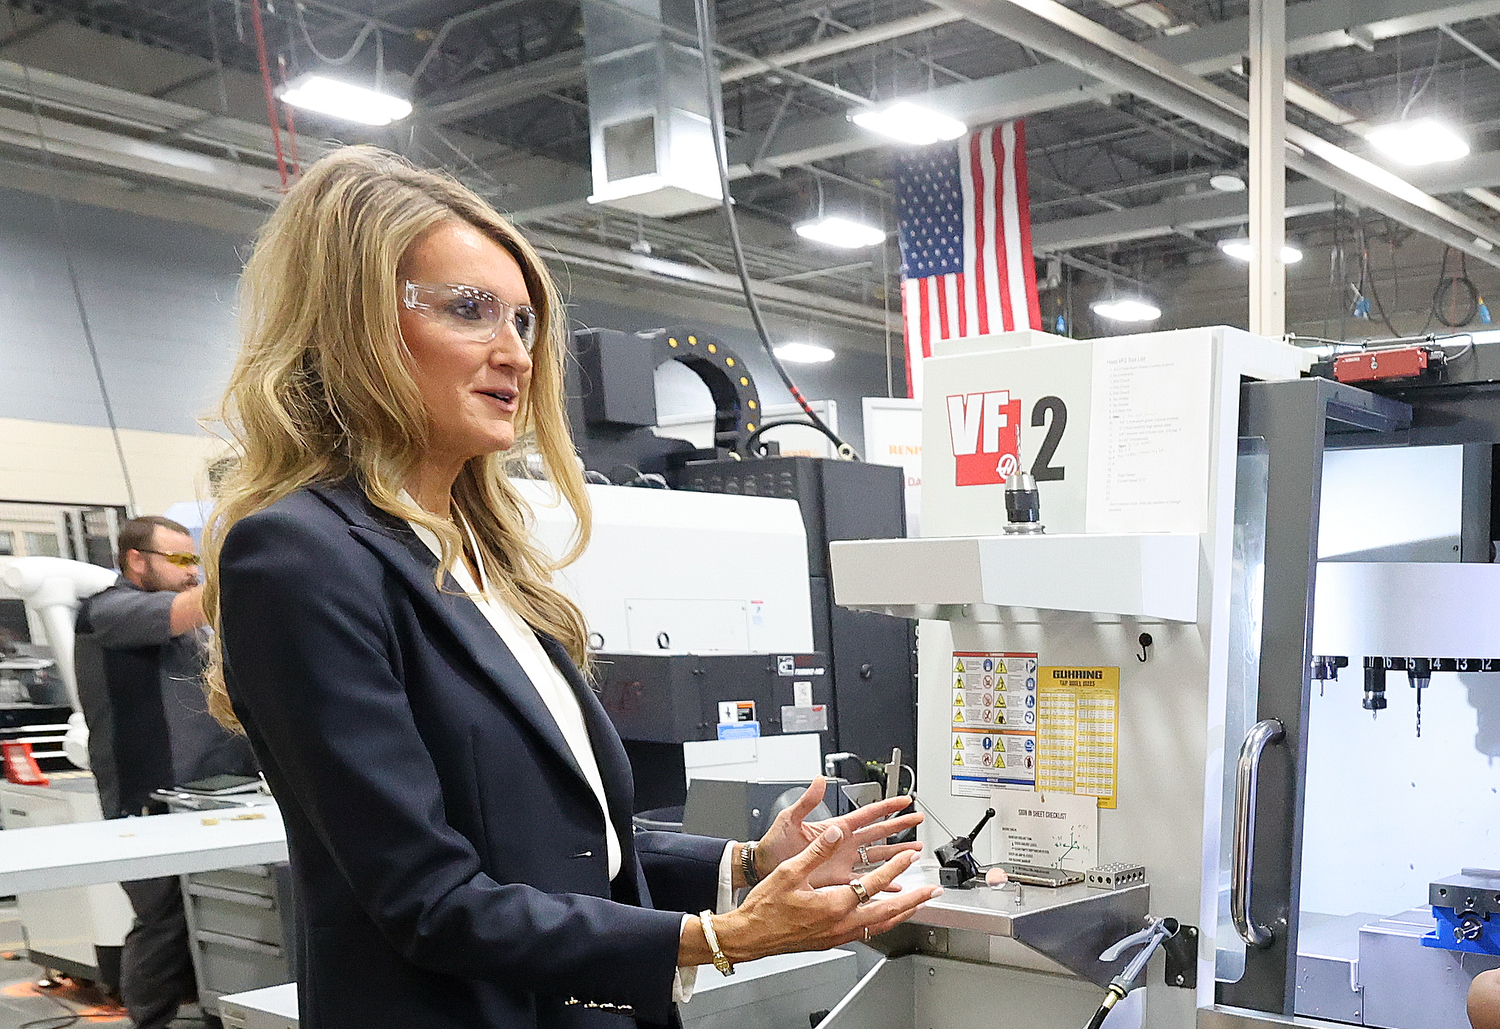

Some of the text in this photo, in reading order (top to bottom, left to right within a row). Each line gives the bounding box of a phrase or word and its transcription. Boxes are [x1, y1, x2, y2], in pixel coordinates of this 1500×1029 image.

[947, 390, 1009, 457] VF
[1031, 396, 1068, 481] 2
[1382, 657, 1392, 668] 16
[1404, 657, 1415, 669] 15
[1428, 658, 1441, 670] 14
[1454, 659, 1468, 670] 13
[1481, 659, 1492, 670] 12
[1053, 670, 1102, 679] GUHRING
[1046, 811, 1066, 819] CHECKLIST
